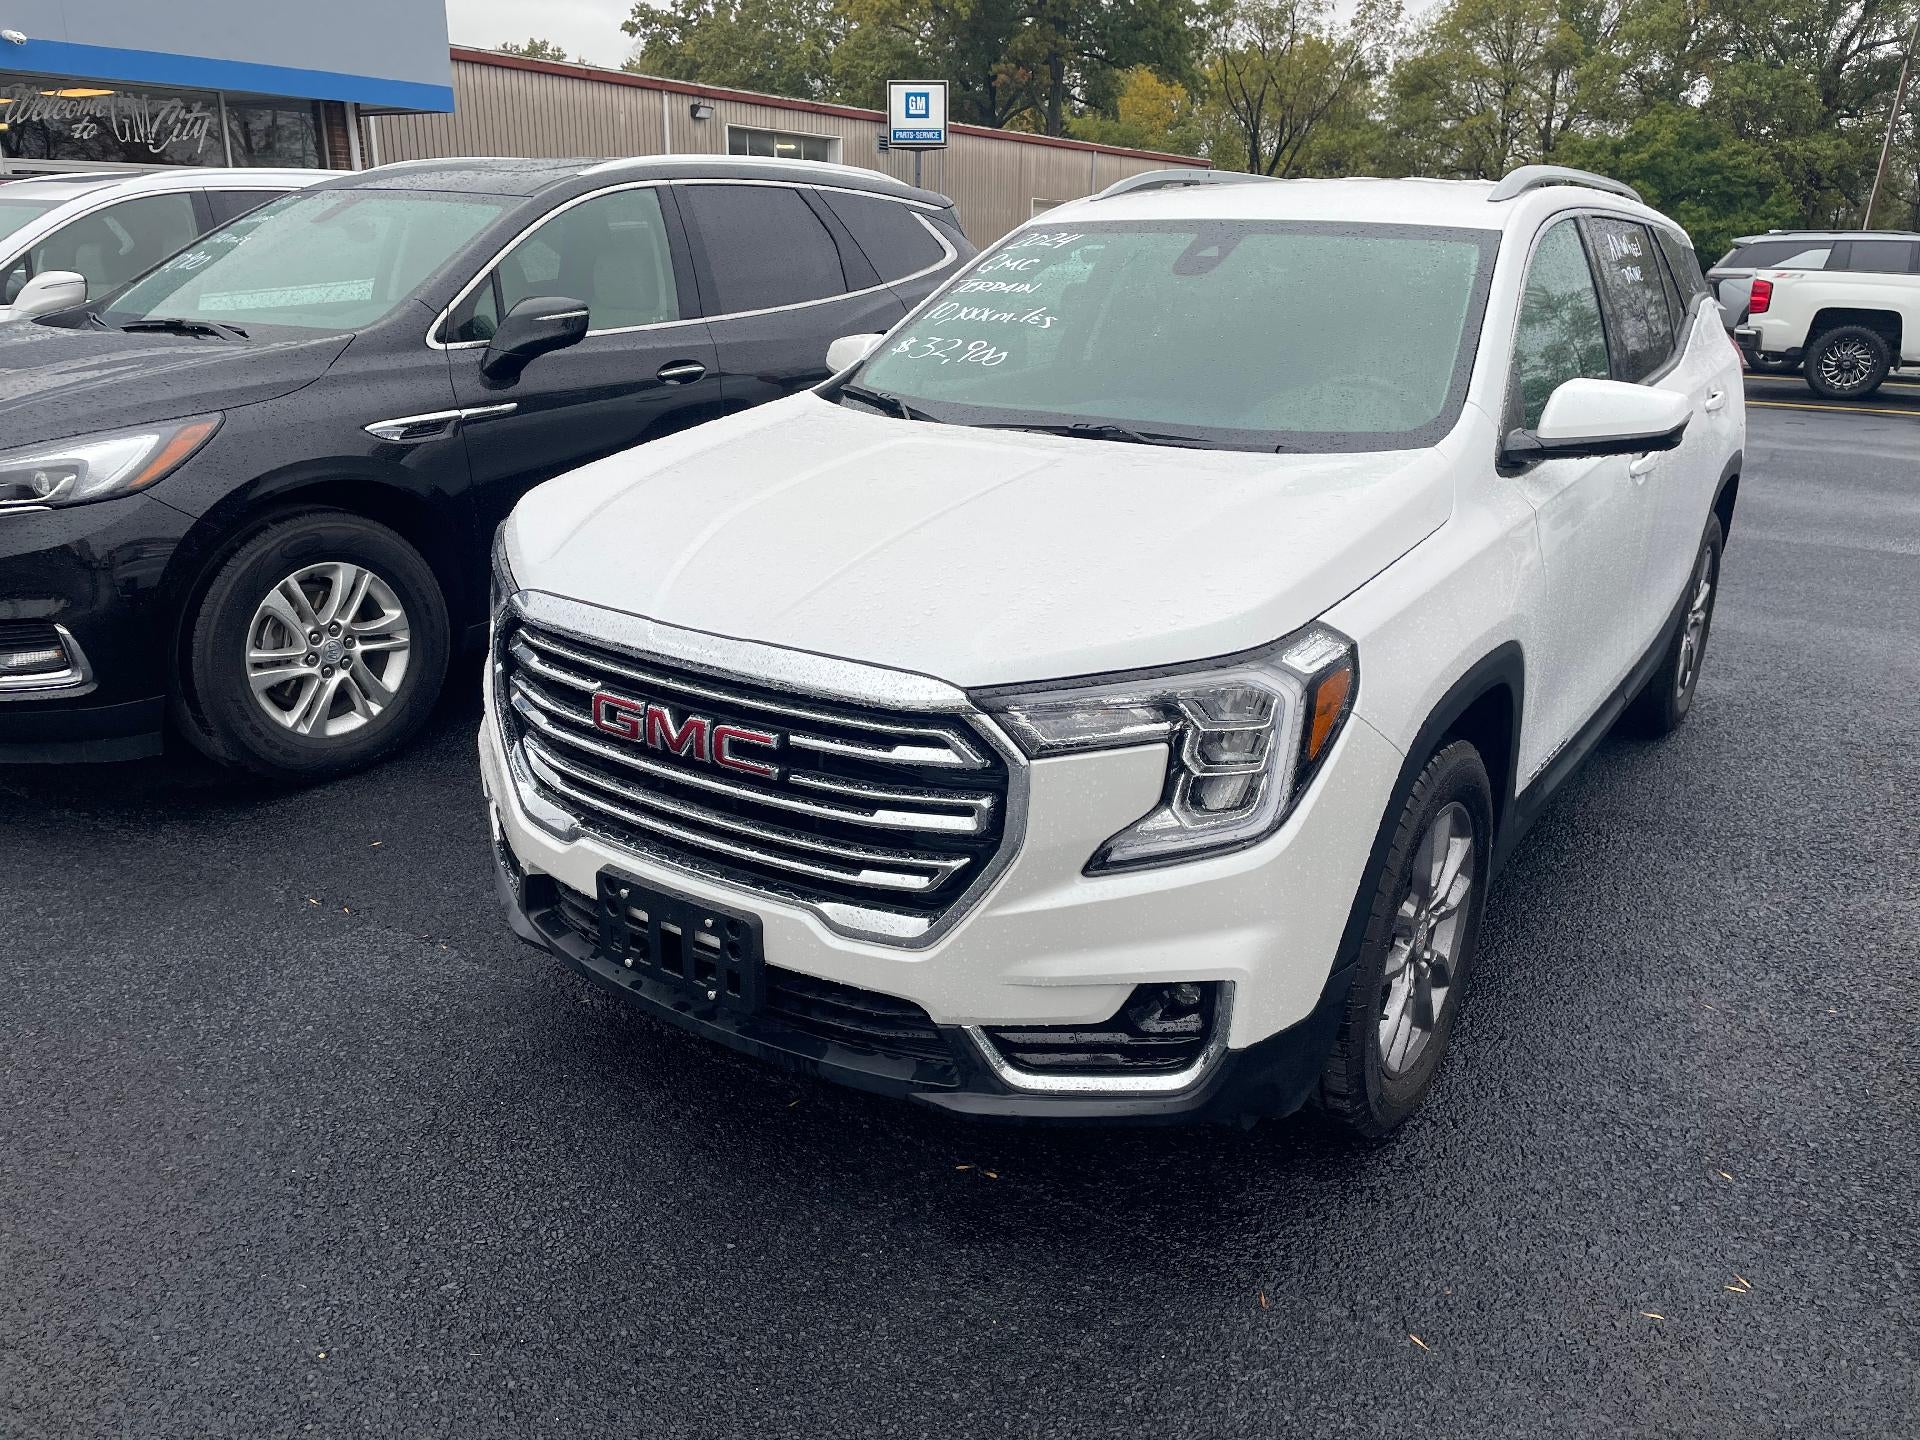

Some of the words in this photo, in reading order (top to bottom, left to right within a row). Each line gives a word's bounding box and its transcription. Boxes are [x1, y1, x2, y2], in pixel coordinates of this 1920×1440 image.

[908, 95, 926, 110] GM
[71, 116, 98, 139] to
[149, 98, 211, 153] City
[1004, 232, 1085, 250] 2024
[976, 253, 1041, 274] GMC
[951, 278, 1042, 294] TERRAIN
[891, 336, 1009, 366] $32,900
[592, 691, 780, 781] GMC
